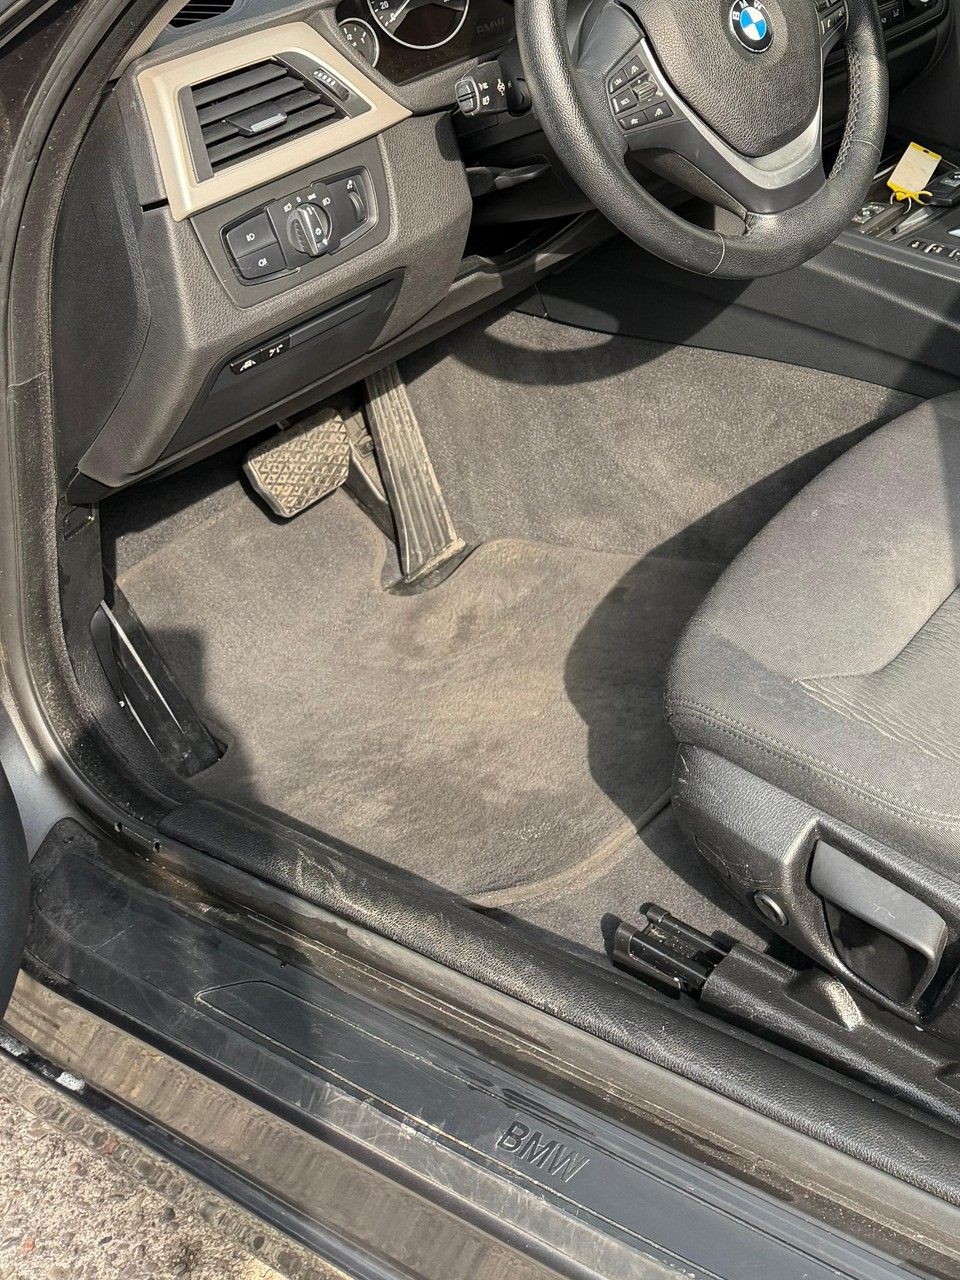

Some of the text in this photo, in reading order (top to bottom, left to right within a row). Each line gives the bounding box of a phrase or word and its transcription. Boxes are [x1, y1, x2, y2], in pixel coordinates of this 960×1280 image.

[380, 0, 389, 10] 20
[733, 0, 762, 21] BMW
[476, 17, 505, 37] BMW
[496, 1121, 590, 1183] BMW
